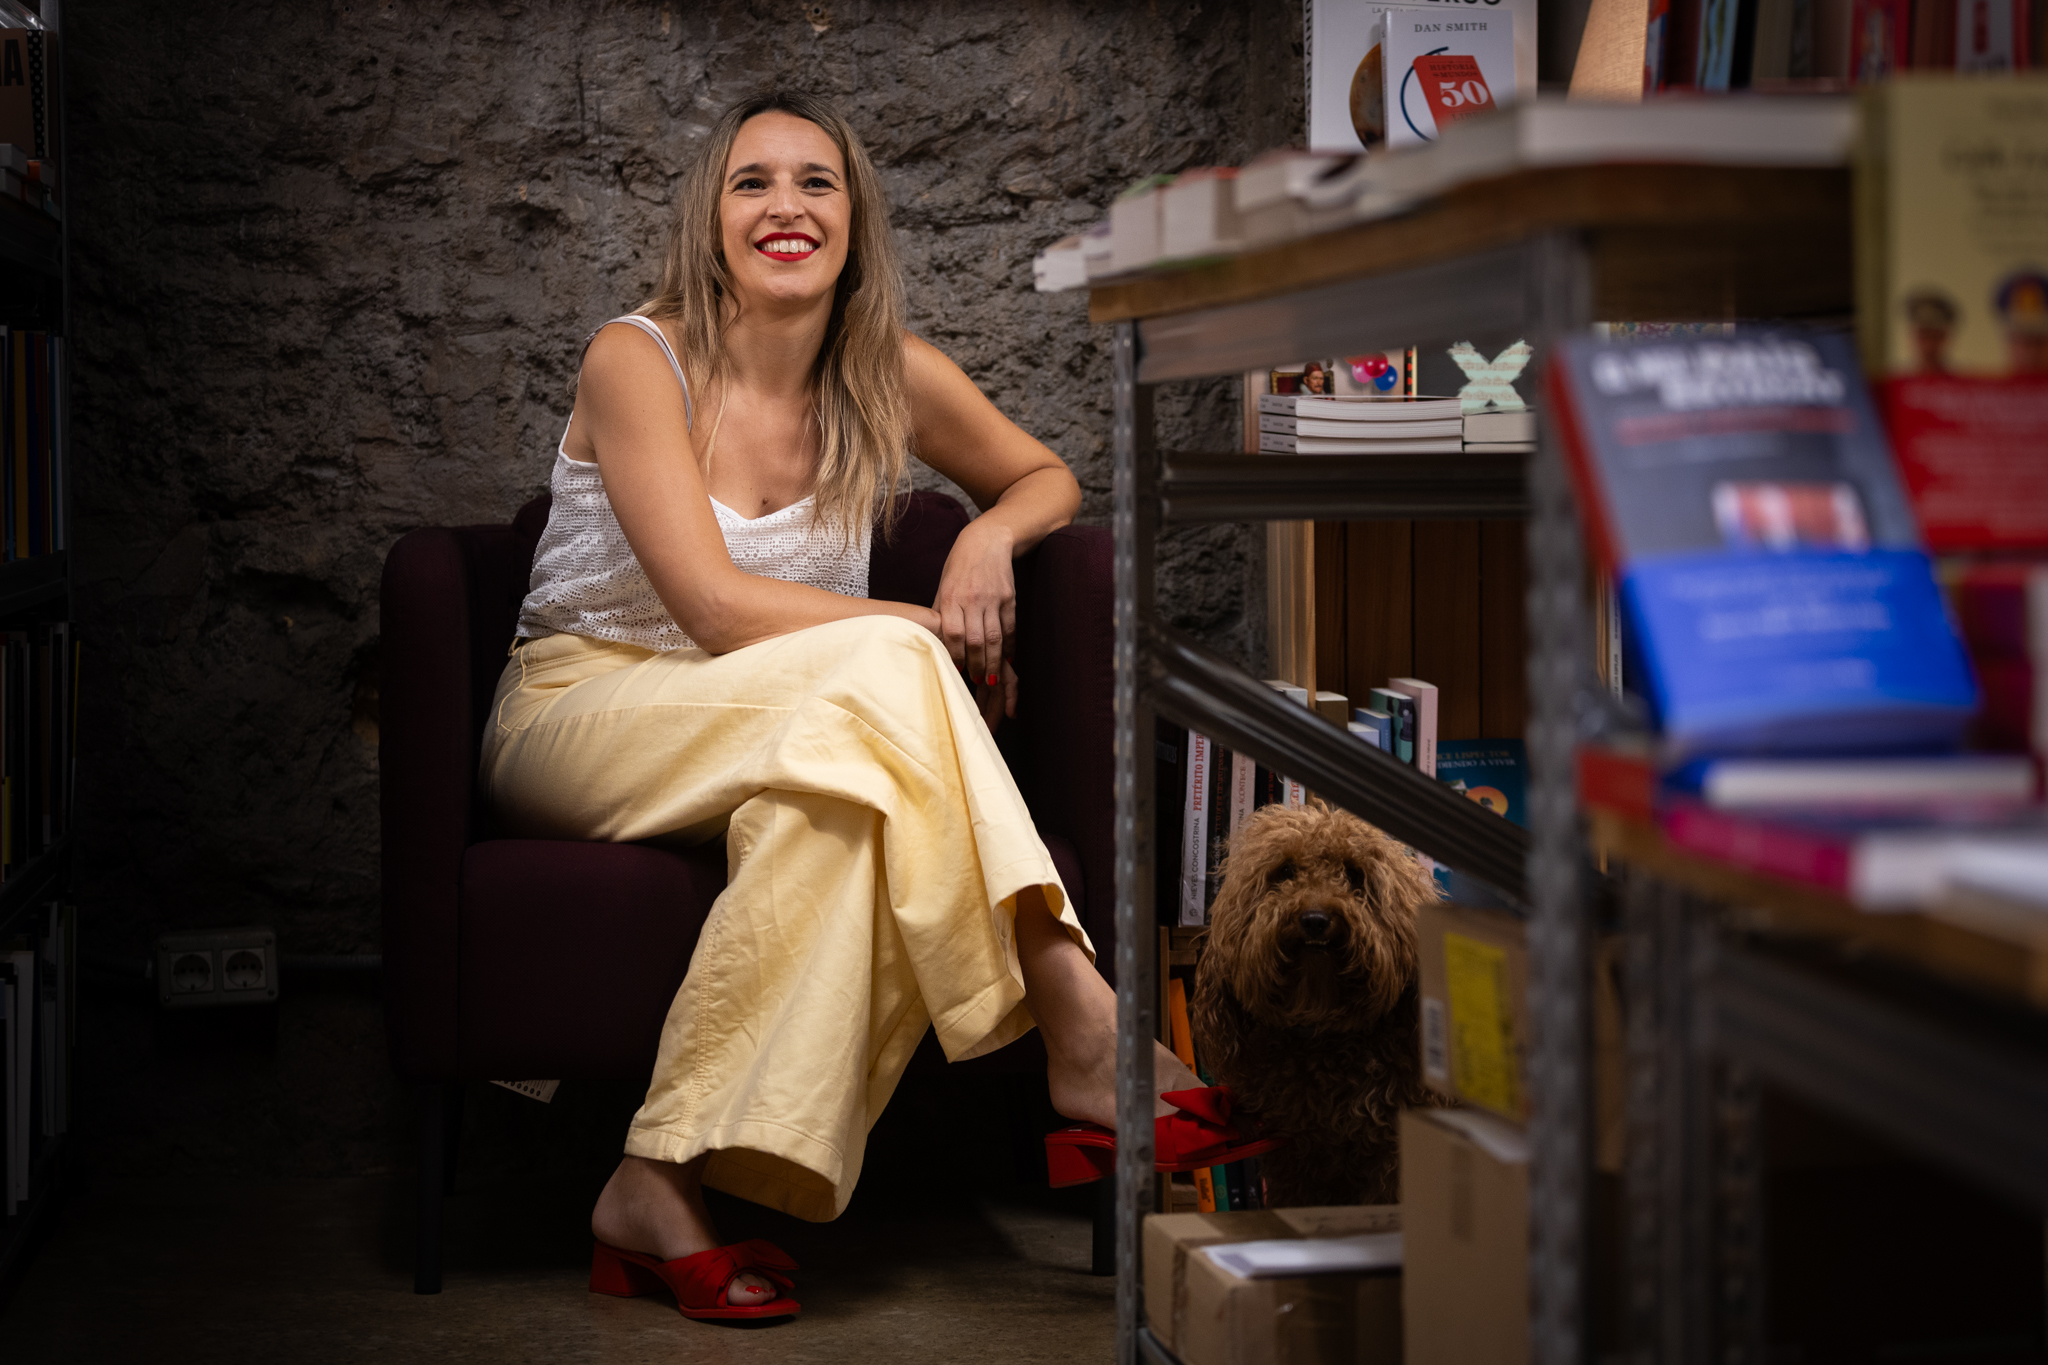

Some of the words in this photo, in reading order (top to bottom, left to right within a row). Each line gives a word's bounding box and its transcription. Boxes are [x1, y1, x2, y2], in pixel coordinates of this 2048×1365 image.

[1414, 23, 1441, 33] DAN
[1445, 22, 1488, 32] SMITH
[1429, 63, 1476, 71] HISTORIA
[1439, 80, 1489, 107] 50
[1455, 750, 1510, 759] LISPECTOR
[1191, 764, 1204, 812] PRETÉRITO
[1191, 817, 1200, 873] CONCOSTRINA
[1190, 873, 1199, 900] NIEVES
